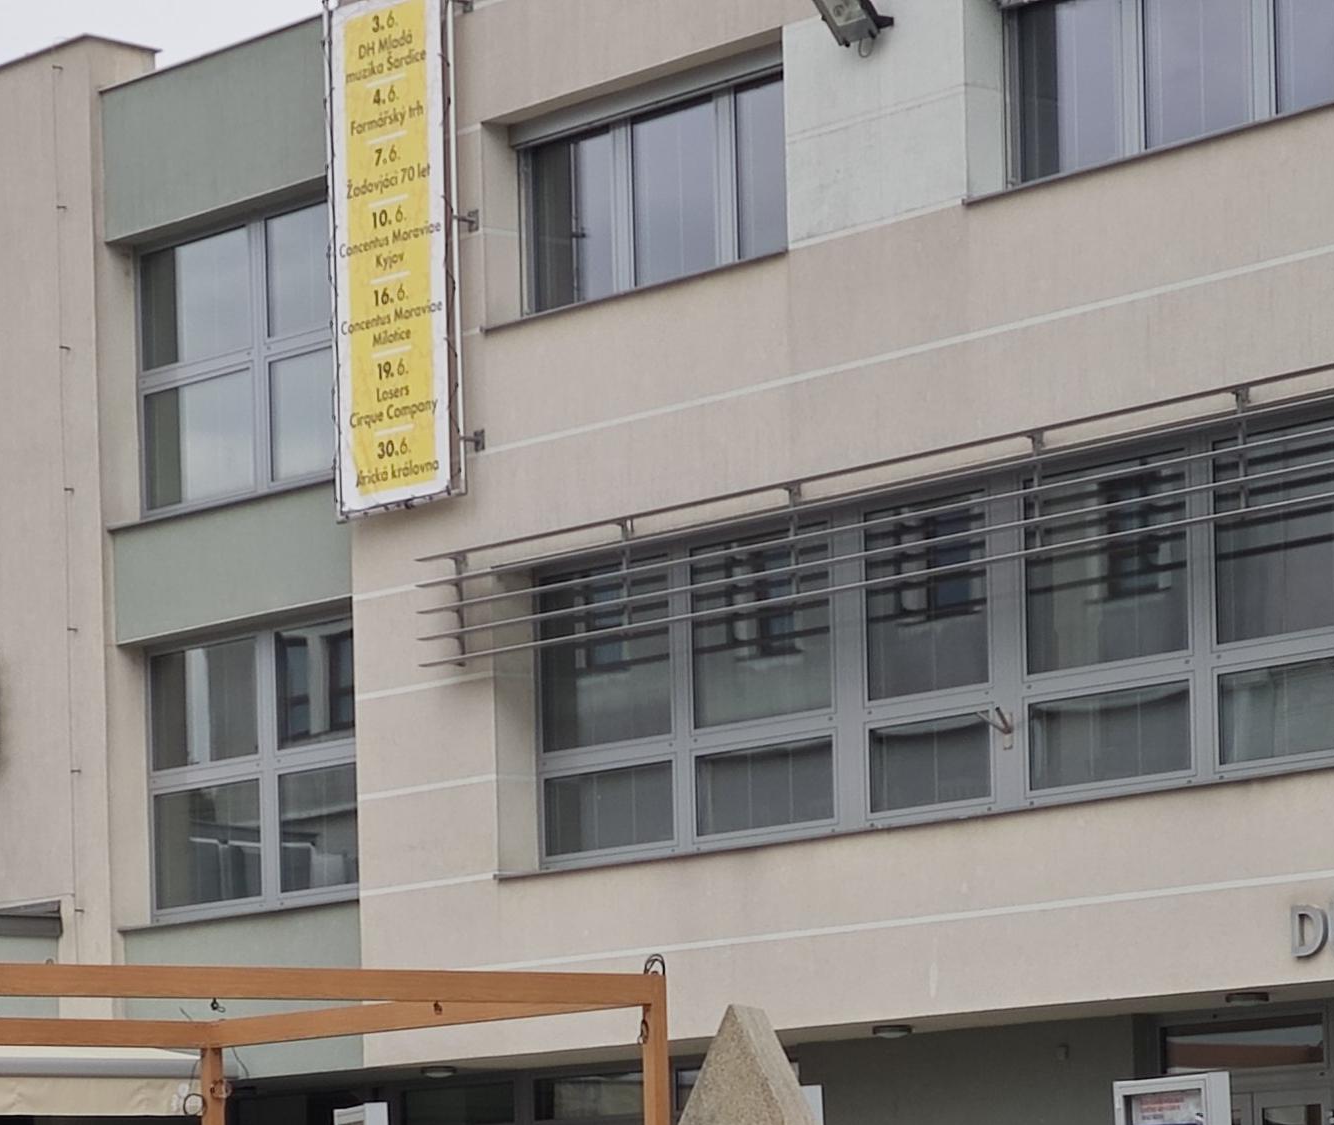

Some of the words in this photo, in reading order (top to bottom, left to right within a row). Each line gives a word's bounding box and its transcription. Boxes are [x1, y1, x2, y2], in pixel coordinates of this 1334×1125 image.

[372, 15, 385, 32] 3.
[358, 41, 375, 59] DH
[379, 29, 413, 53] Mladá
[346, 60, 384, 85] muzika
[387, 50, 427, 71] Šardice
[373, 89, 386, 105] 4.
[350, 106, 407, 136] Farmářský
[408, 100, 423, 119] trh
[375, 148, 387, 167] 7.
[400, 166, 415, 183] 70
[417, 162, 431, 179] let
[372, 209, 393, 229] 10.
[339, 235, 389, 258] Concentus
[375, 250, 404, 270] Kyjov
[374, 288, 394, 306] 16.
[341, 314, 391, 336] Concentus
[372, 327, 412, 347] Milotice
[377, 361, 395, 380] 19.
[376, 385, 410, 402] Losers
[349, 411, 384, 428] Cirque
[387, 398, 438, 419] Company
[377, 440, 398, 459] 30.
[391, 459, 440, 479] královna
